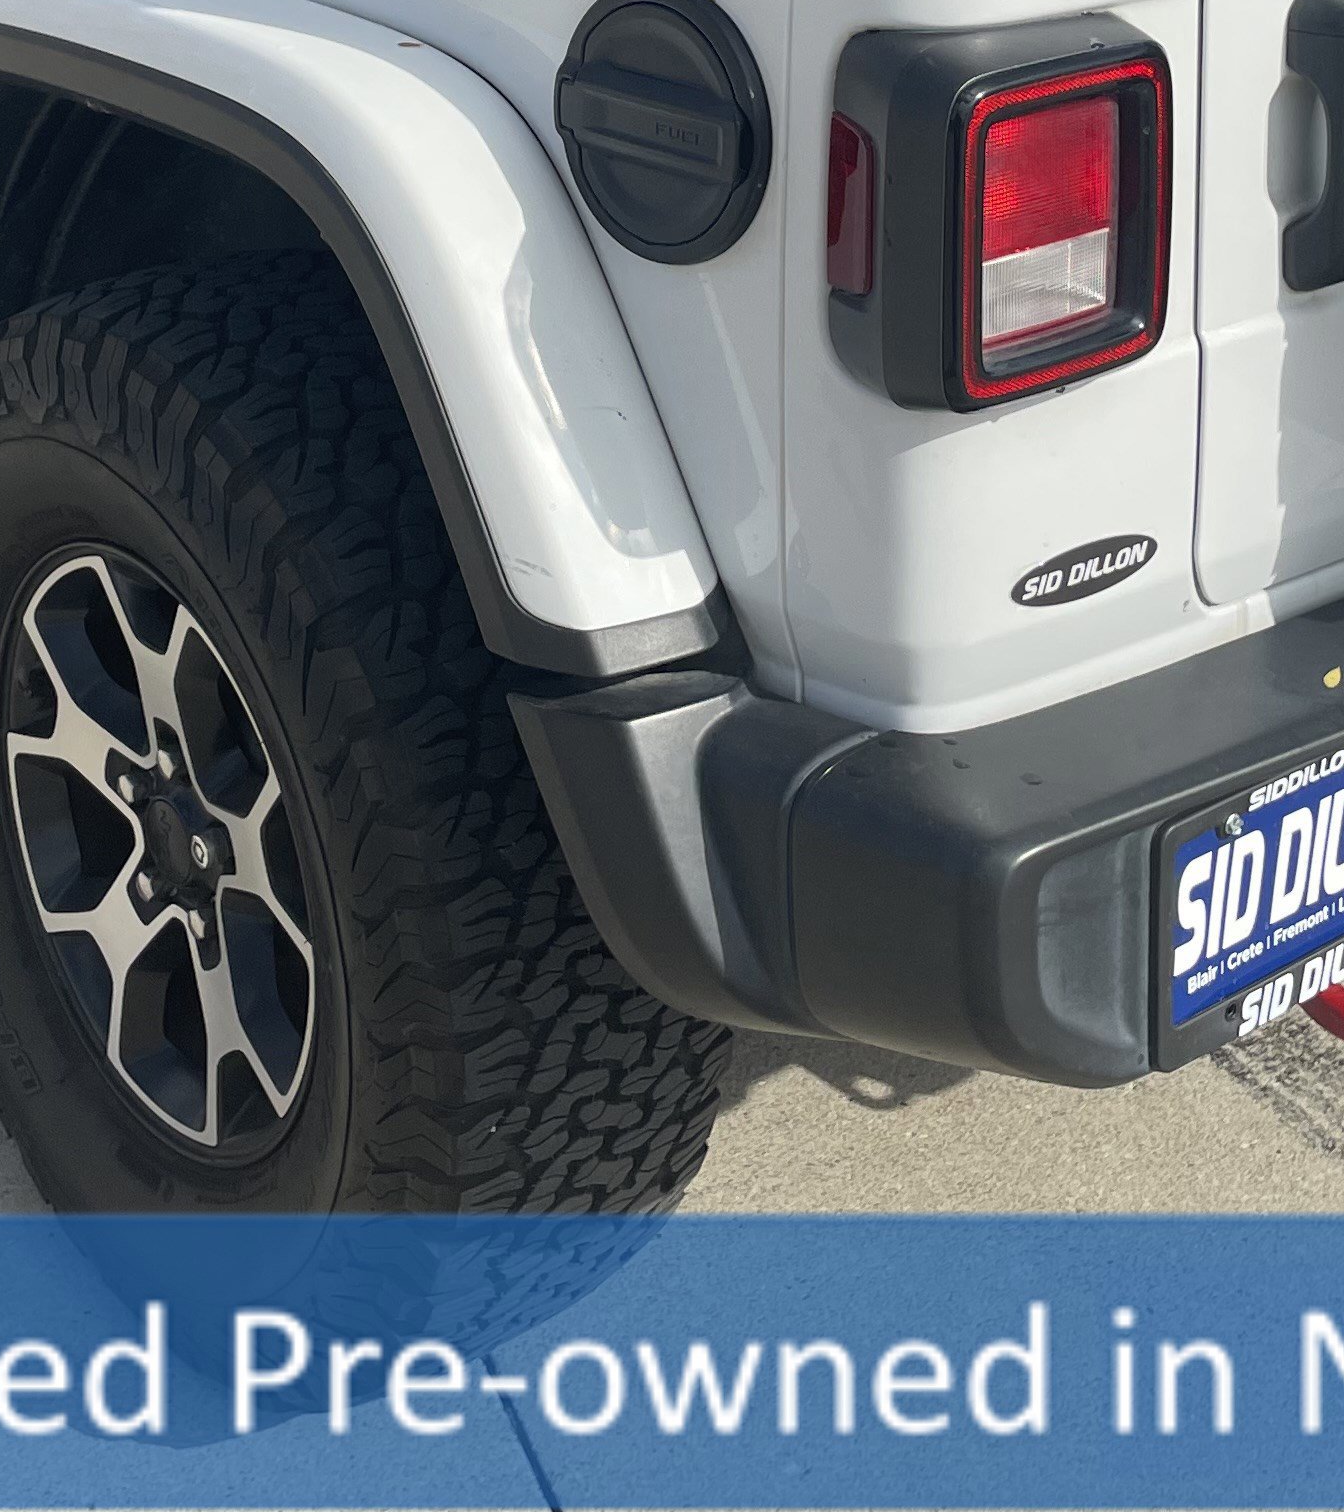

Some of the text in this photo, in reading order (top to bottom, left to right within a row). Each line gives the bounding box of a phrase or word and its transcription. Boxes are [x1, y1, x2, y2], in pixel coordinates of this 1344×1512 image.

[656, 122, 700, 146] FUEL
[1022, 540, 1148, 601] SID DILLON
[1173, 830, 1265, 977] SID
[1187, 964, 1218, 995] Blair
[1227, 941, 1263, 972] Crete
[1273, 905, 1329, 946] Fremont
[1238, 972, 1293, 1037] SID
